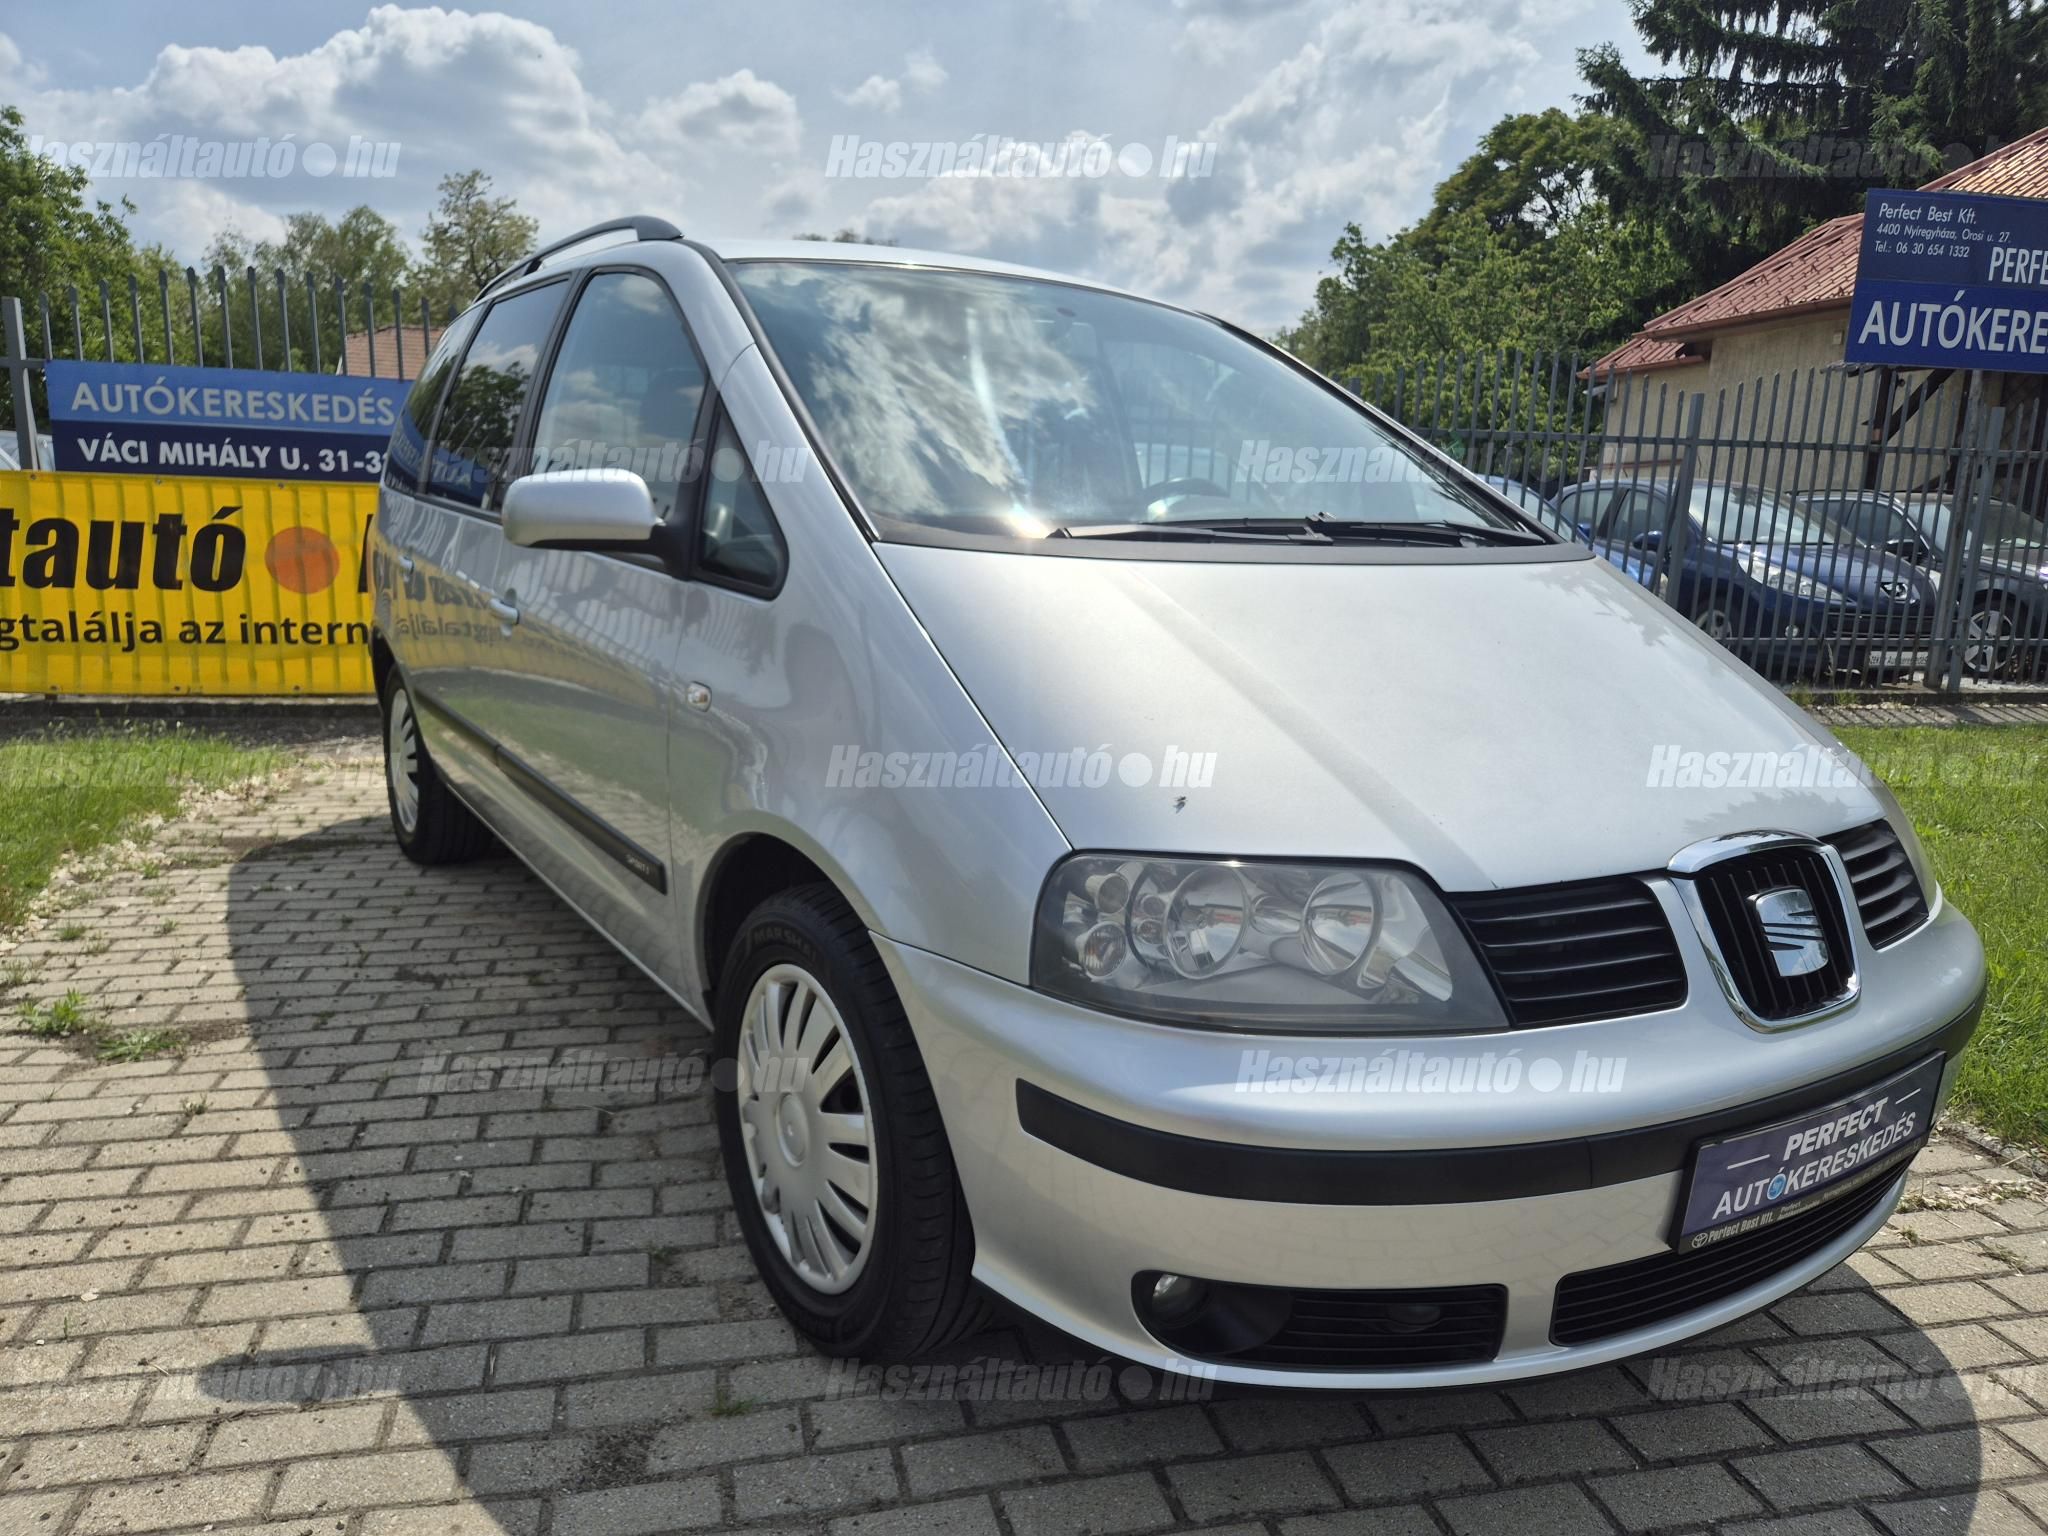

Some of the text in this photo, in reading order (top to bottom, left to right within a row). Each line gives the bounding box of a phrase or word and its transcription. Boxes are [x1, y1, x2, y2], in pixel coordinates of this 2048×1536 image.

[1878, 203, 1977, 225] Perfect Best Kft.
[1876, 223, 1901, 236] 4400
[1961, 228, 1985, 241] Orosi
[1986, 233, 1994, 242] u.
[1874, 240, 1970, 258] Tel.: 06 30 654 1332
[72, 376, 396, 427] AUTÓKERESKEDÉS
[77, 432, 388, 474] VÁCI MIHÁLY U. 31-3
[178, 620, 227, 644] az
[1783, 1097, 1889, 1161] PERFECT
[1712, 1112, 1917, 1220] AUTÓKERESKEDÉS
[1708, 1223, 1740, 1243] Perfect
[1741, 1216, 1760, 1232] Best
